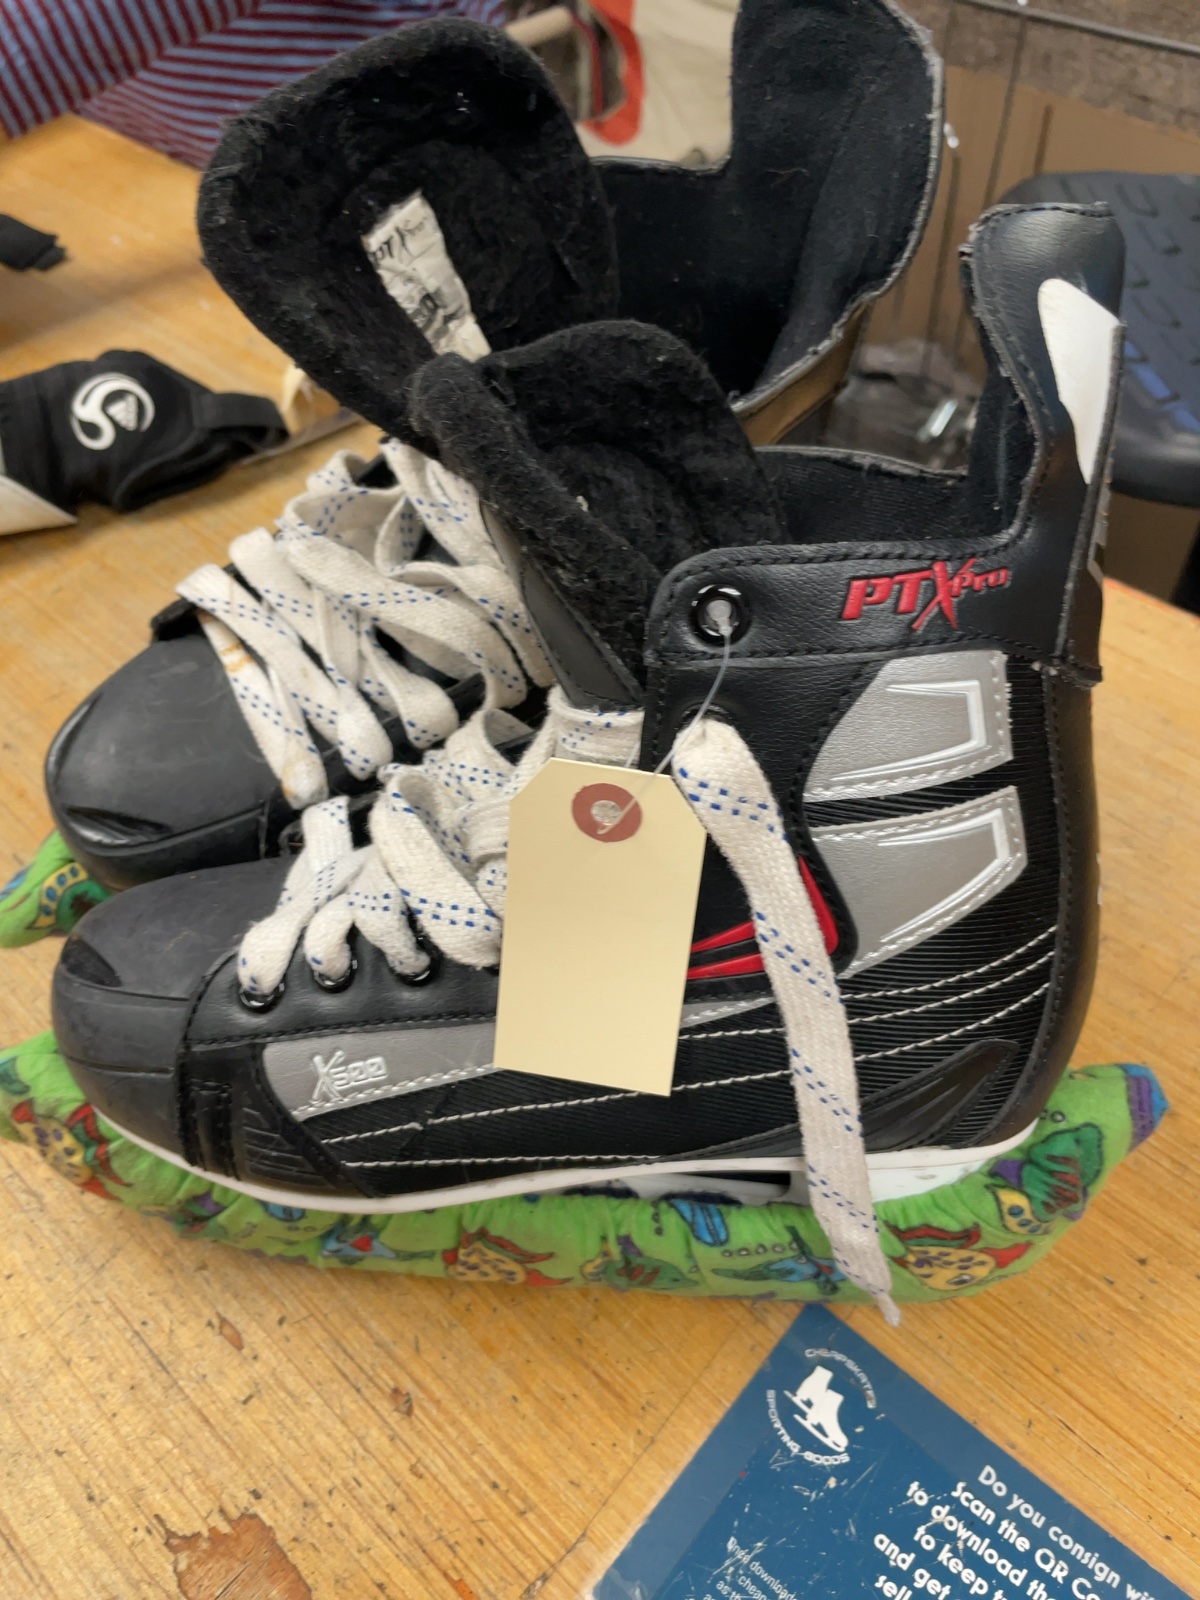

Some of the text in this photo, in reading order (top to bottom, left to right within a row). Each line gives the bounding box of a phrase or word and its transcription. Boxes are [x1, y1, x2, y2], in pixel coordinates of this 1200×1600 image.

[803, 1451, 851, 1465] GOODS
[906, 1481, 1055, 1600] to download th
[913, 1525, 936, 1551] to
[937, 1543, 989, 1596] keep
[951, 1481, 996, 1526] Scan
[997, 1518, 1031, 1553] the
[1034, 1547, 1069, 1584] QR
[978, 1464, 1007, 1497] Do
[1006, 1493, 1046, 1529] you
[1048, 1526, 1121, 1589] consign
[716, 1580, 731, 1595] as
[873, 1533, 951, 1600] and get
